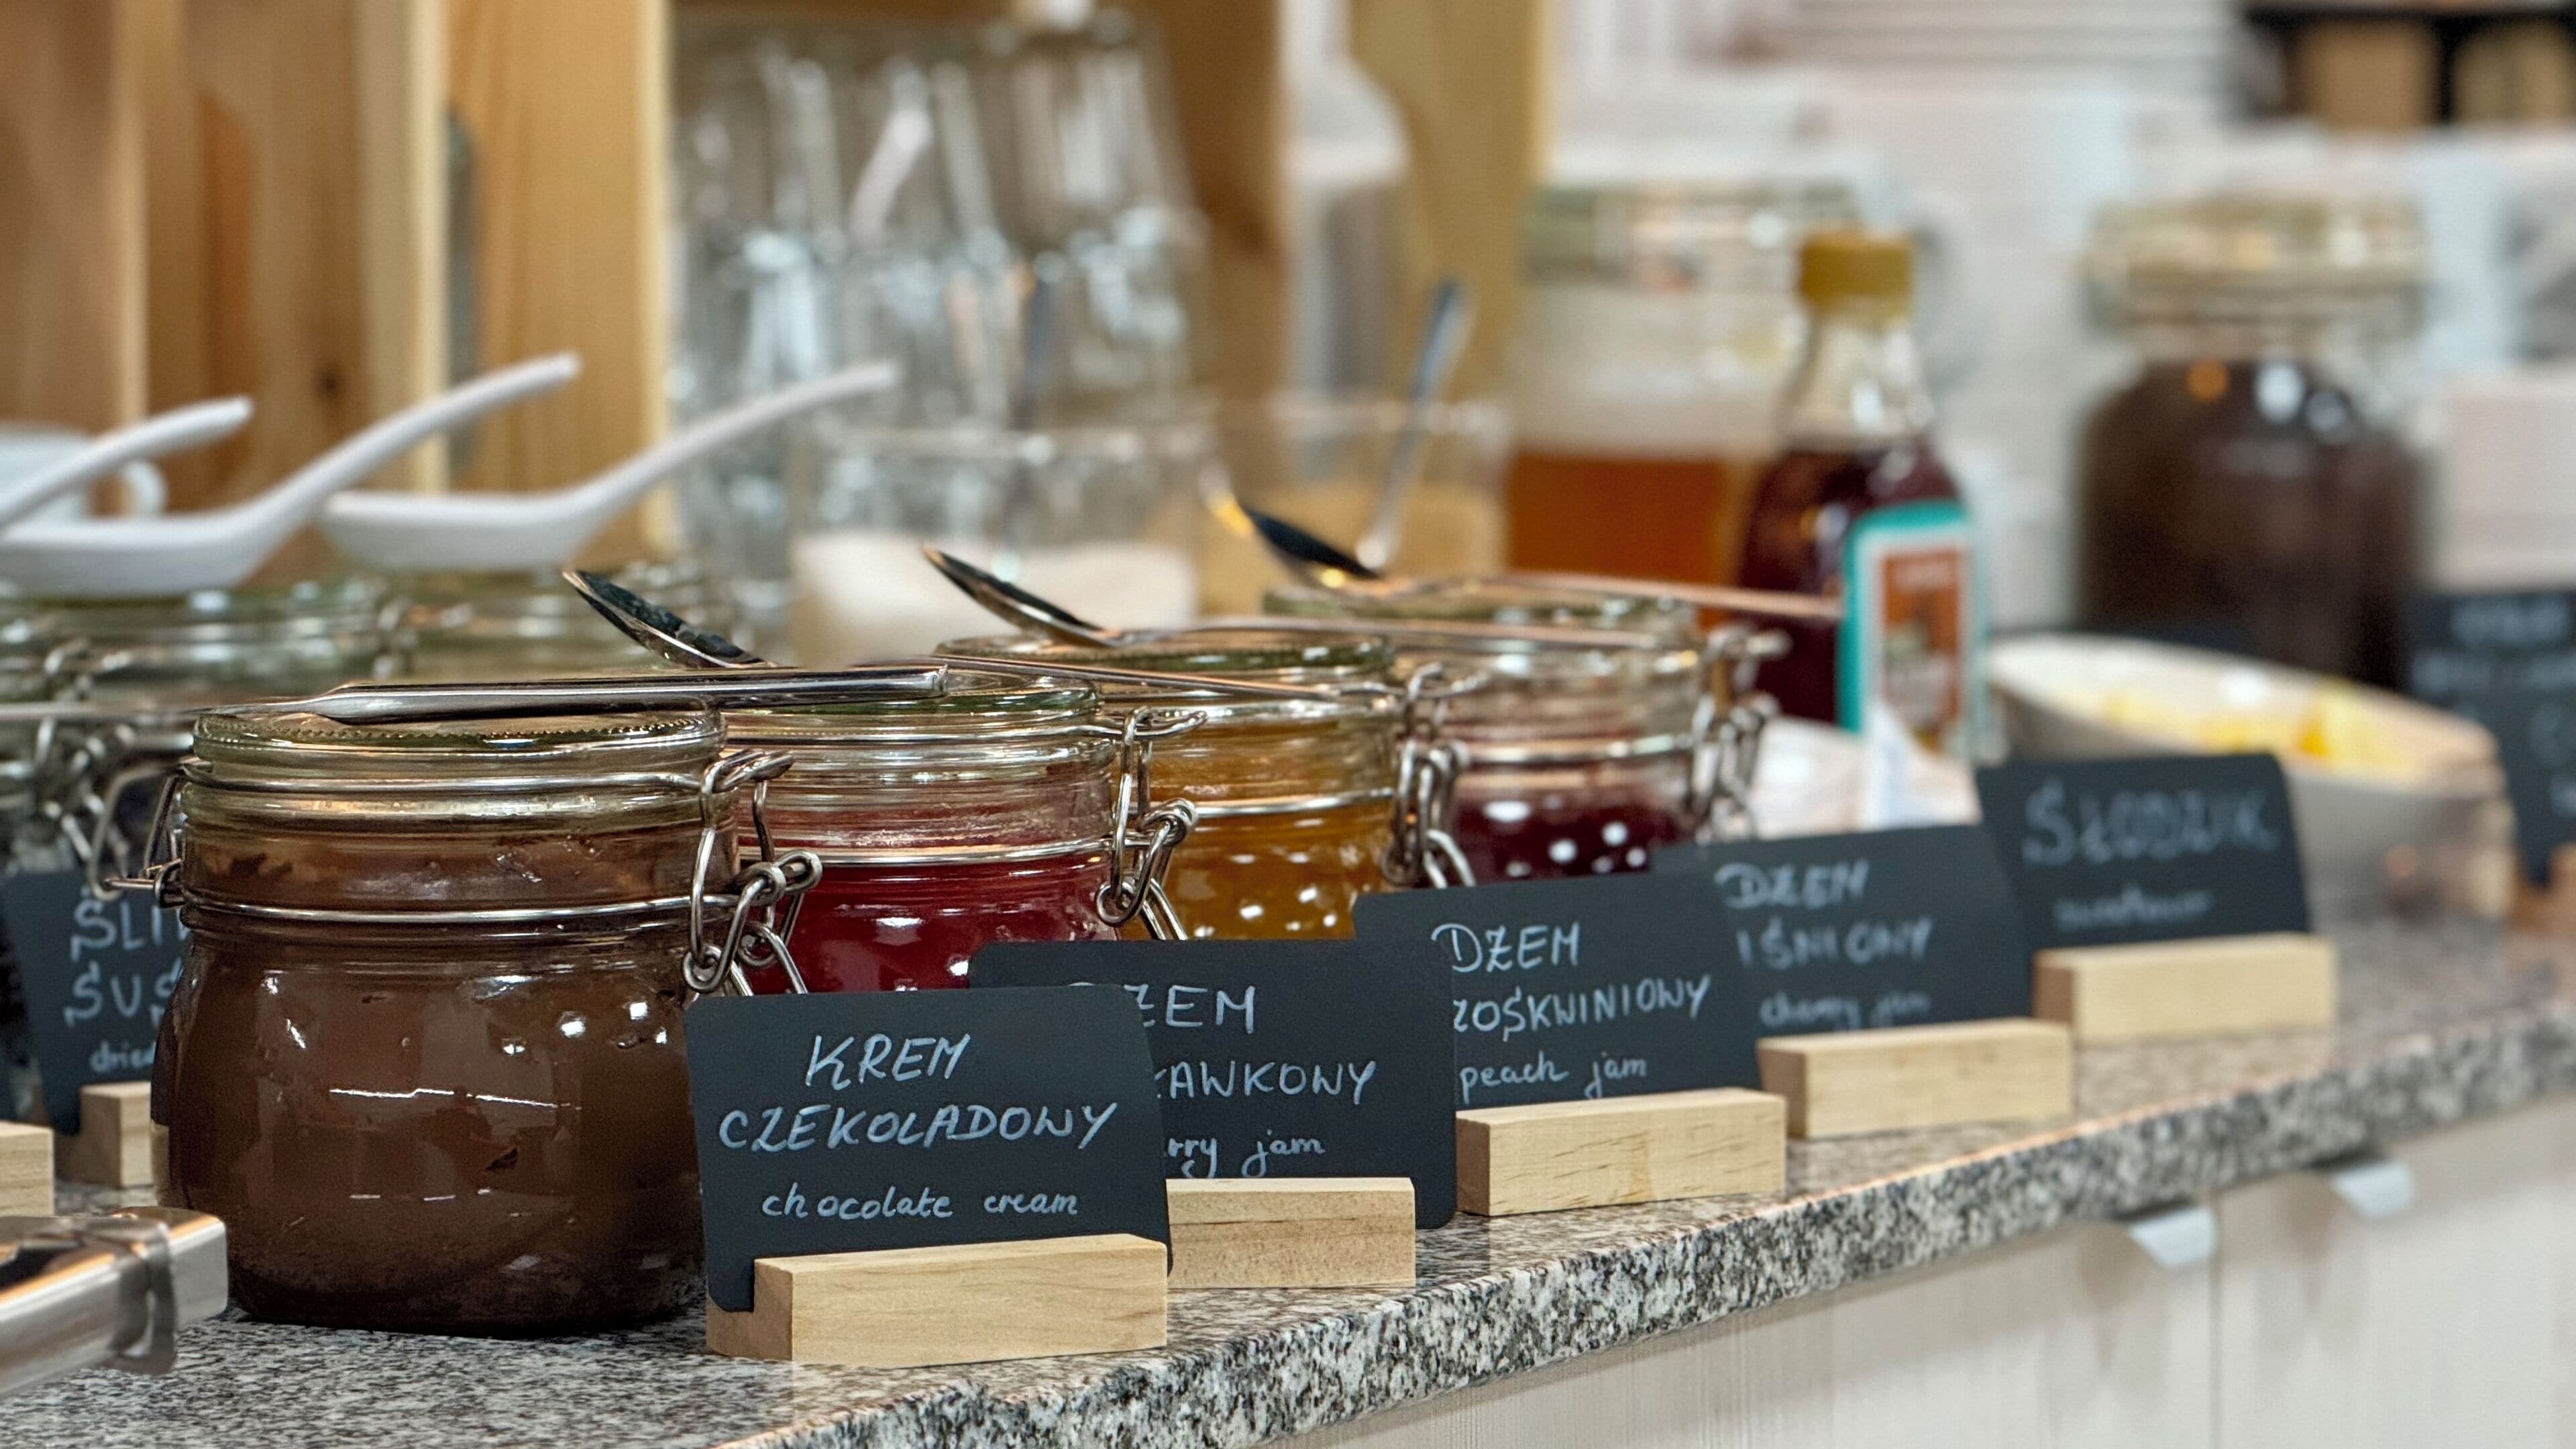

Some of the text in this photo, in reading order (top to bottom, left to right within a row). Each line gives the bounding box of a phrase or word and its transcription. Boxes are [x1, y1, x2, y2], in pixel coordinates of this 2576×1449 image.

[1452, 974, 1712, 1042] ZOSKWINIOWY
[805, 1033, 971, 1090] KREM
[1154, 1060, 1377, 1105] AWKOWY
[1460, 1051, 1648, 1105] peach jam
[718, 1102, 1118, 1152] CZEKOLADOWY
[1241, 1129, 1326, 1179] jam
[762, 1182, 1079, 1220] chocolate cream
